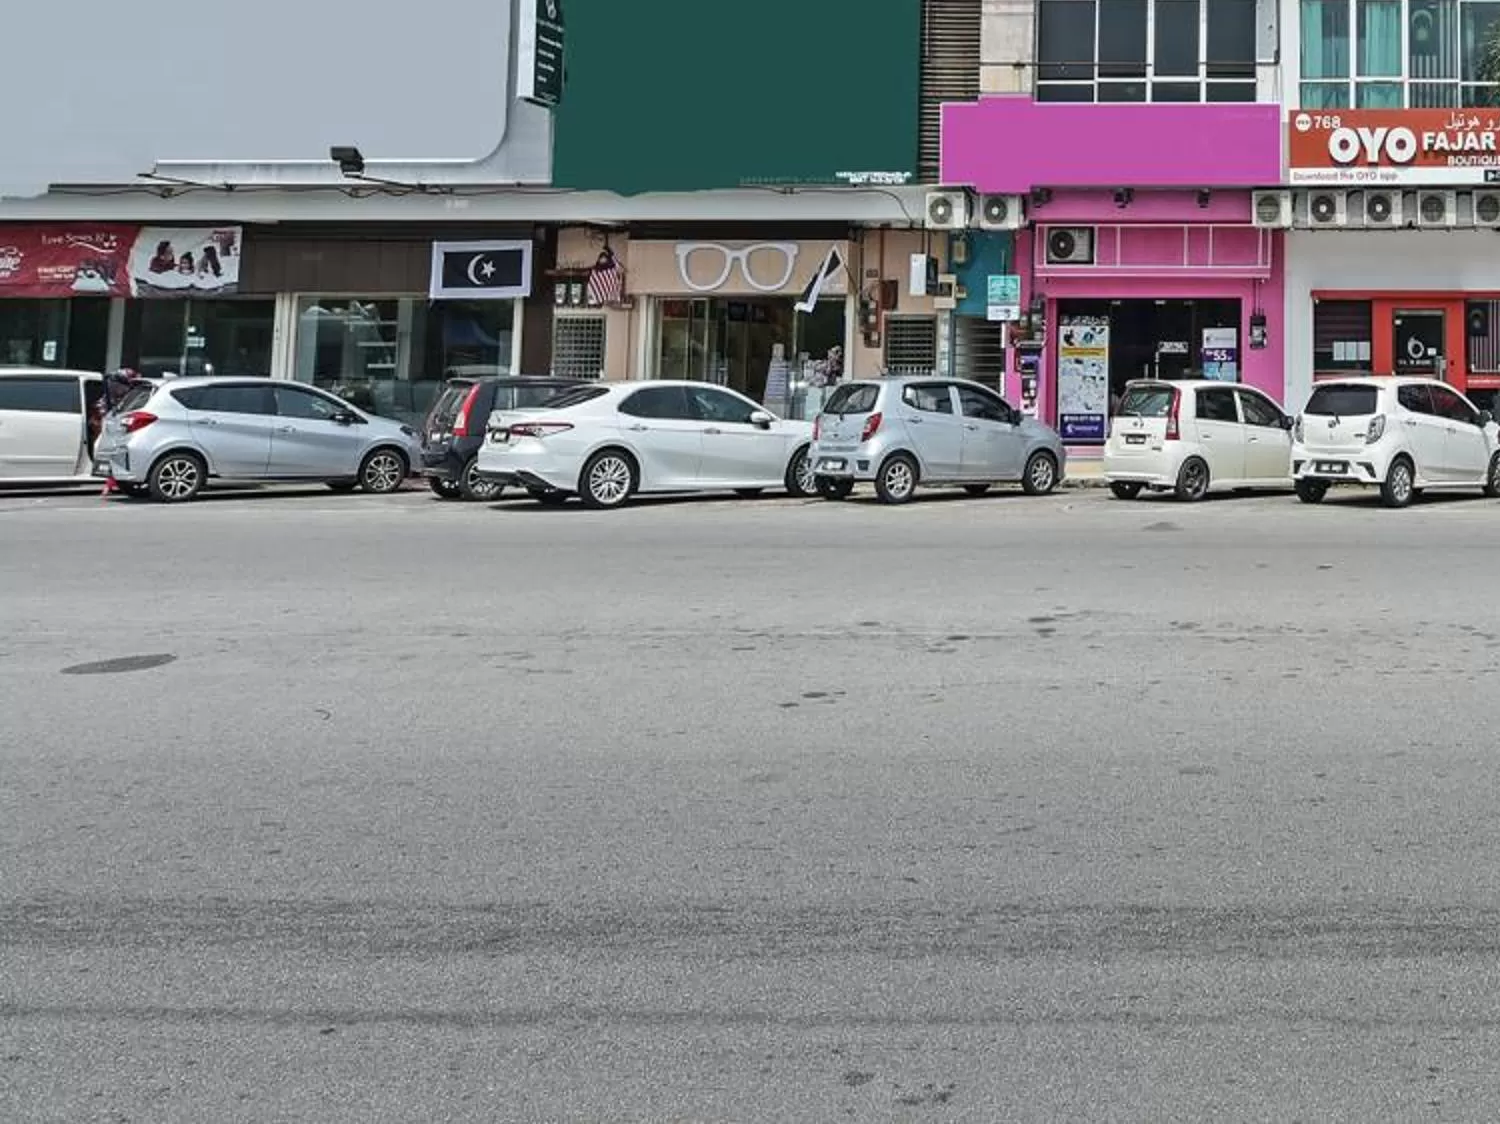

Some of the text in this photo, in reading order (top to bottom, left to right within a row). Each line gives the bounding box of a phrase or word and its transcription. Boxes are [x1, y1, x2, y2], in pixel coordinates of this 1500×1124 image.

[1314, 116, 1341, 129] 768
[1328, 127, 1417, 163] OYO
[1421, 131, 1496, 151] FAJAR
[1356, 172, 1377, 181] OYO
